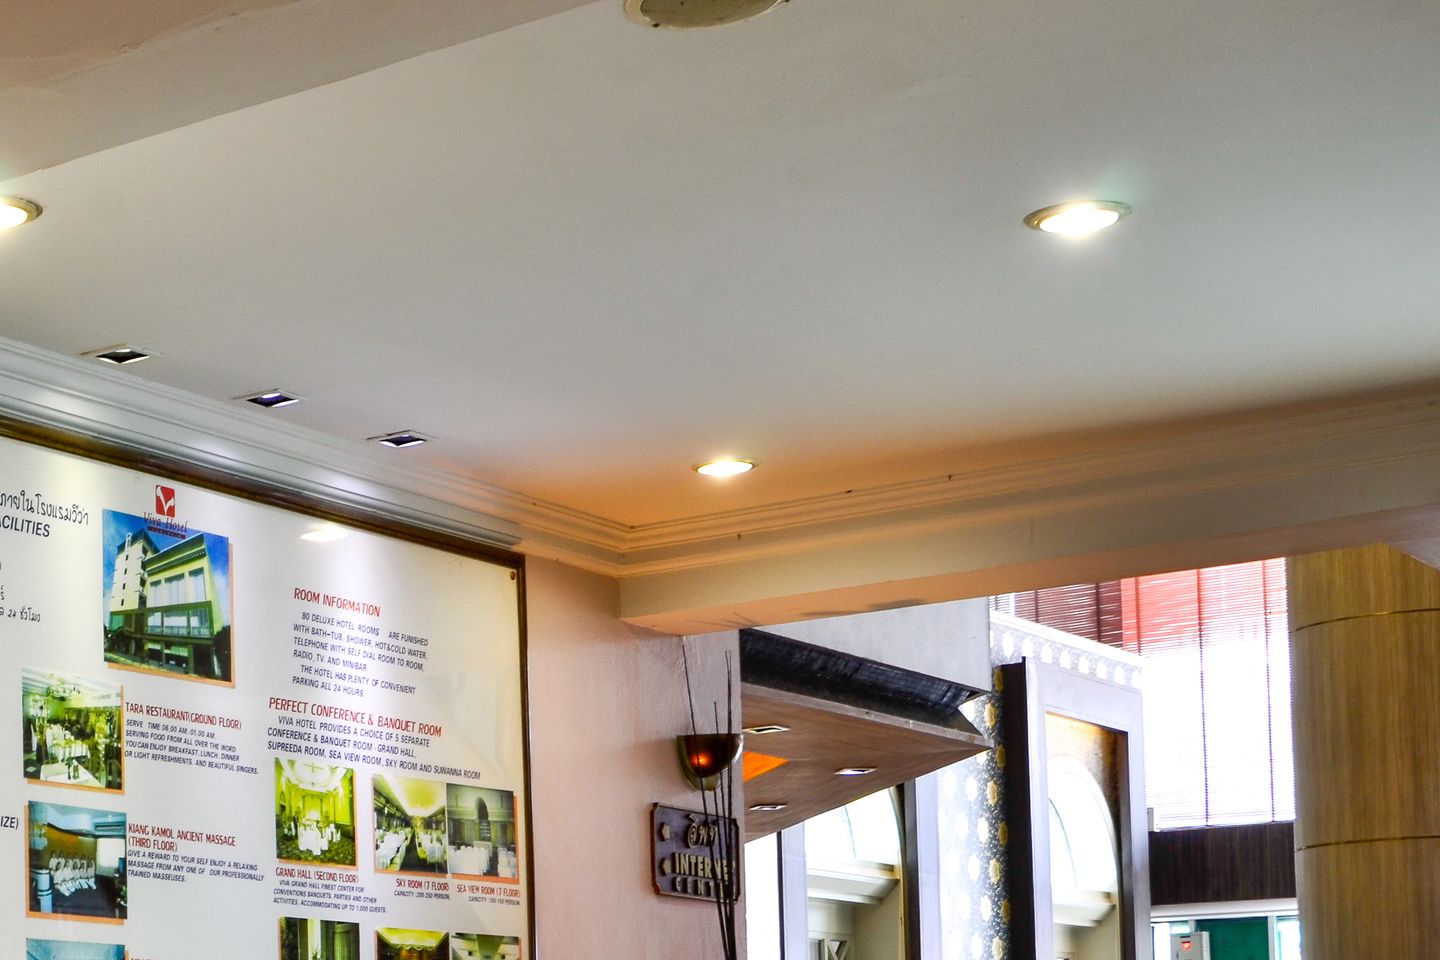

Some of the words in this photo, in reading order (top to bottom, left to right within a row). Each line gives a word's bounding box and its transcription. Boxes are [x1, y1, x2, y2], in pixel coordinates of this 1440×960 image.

[294, 588, 320, 604] ROOM
[323, 594, 381, 617] INFORMATION
[312, 614, 335, 626] DELUXE
[336, 618, 355, 630] HOTEL
[388, 631, 399, 641] ARE
[301, 664, 312, 674] THE
[314, 667, 333, 679] HOTEL
[292, 676, 319, 688] PARKING
[320, 681, 331, 691] ALL
[125, 702, 144, 715] TARA
[219, 716, 242, 730] FLOOR)
[268, 697, 308, 714] PERFECT
[311, 703, 366, 724] CONFERENCE
[367, 713, 374, 726] &
[378, 715, 416, 733] BANQUET
[418, 722, 442, 737] ROOM
[125, 729, 149, 739] SERVING
[150, 732, 165, 741] FOOD
[167, 735, 182, 743] FROM
[278, 715, 294, 726] VIVA
[296, 718, 317, 730] HOTEL
[320, 722, 352, 735] PROVIDES
[360, 728, 384, 740] CHOICE
[385, 732, 393, 741] OF
[400, 735, 430, 748] SEPARATE
[267, 727, 311, 742] CONFERENCE
[313, 734, 318, 743] &
[320, 735, 351, 748] BANQUET
[377, 743, 398, 755] GRAND
[267, 740, 302, 754] SUPREEDA
[329, 749, 342, 760] SEA
[344, 752, 361, 762] VIEW
[385, 758, 398, 768] SKY
[399, 760, 418, 771] ROOM
[419, 764, 433, 774] AND
[463, 769, 481, 780] ROOM
[128, 836, 151, 849] (THIRD
[153, 839, 178, 852] FLOOR)
[151, 826, 175, 840] KAMOL
[176, 830, 203, 844] ANCIENT
[206, 833, 236, 847] MASSAGE
[128, 849, 141, 858] GIVE
[142, 851, 147, 859] A
[148, 852, 171, 861] REWARD
[172, 854, 180, 862] TO
[180, 855, 195, 864] YOUR
[195, 857, 208, 866] SELF
[209, 859, 226, 868] ENJOY
[128, 860, 154, 870] MASSAGE
[156, 863, 172, 871] FROM
[186, 866, 197, 874] ONE
[128, 869, 151, 879] TRAINED
[275, 866, 295, 878] GRAND
[297, 869, 311, 880] HALL
[396, 878, 406, 888] SKY
[407, 879, 423, 890] ROOM
[456, 883, 467, 893] SEA
